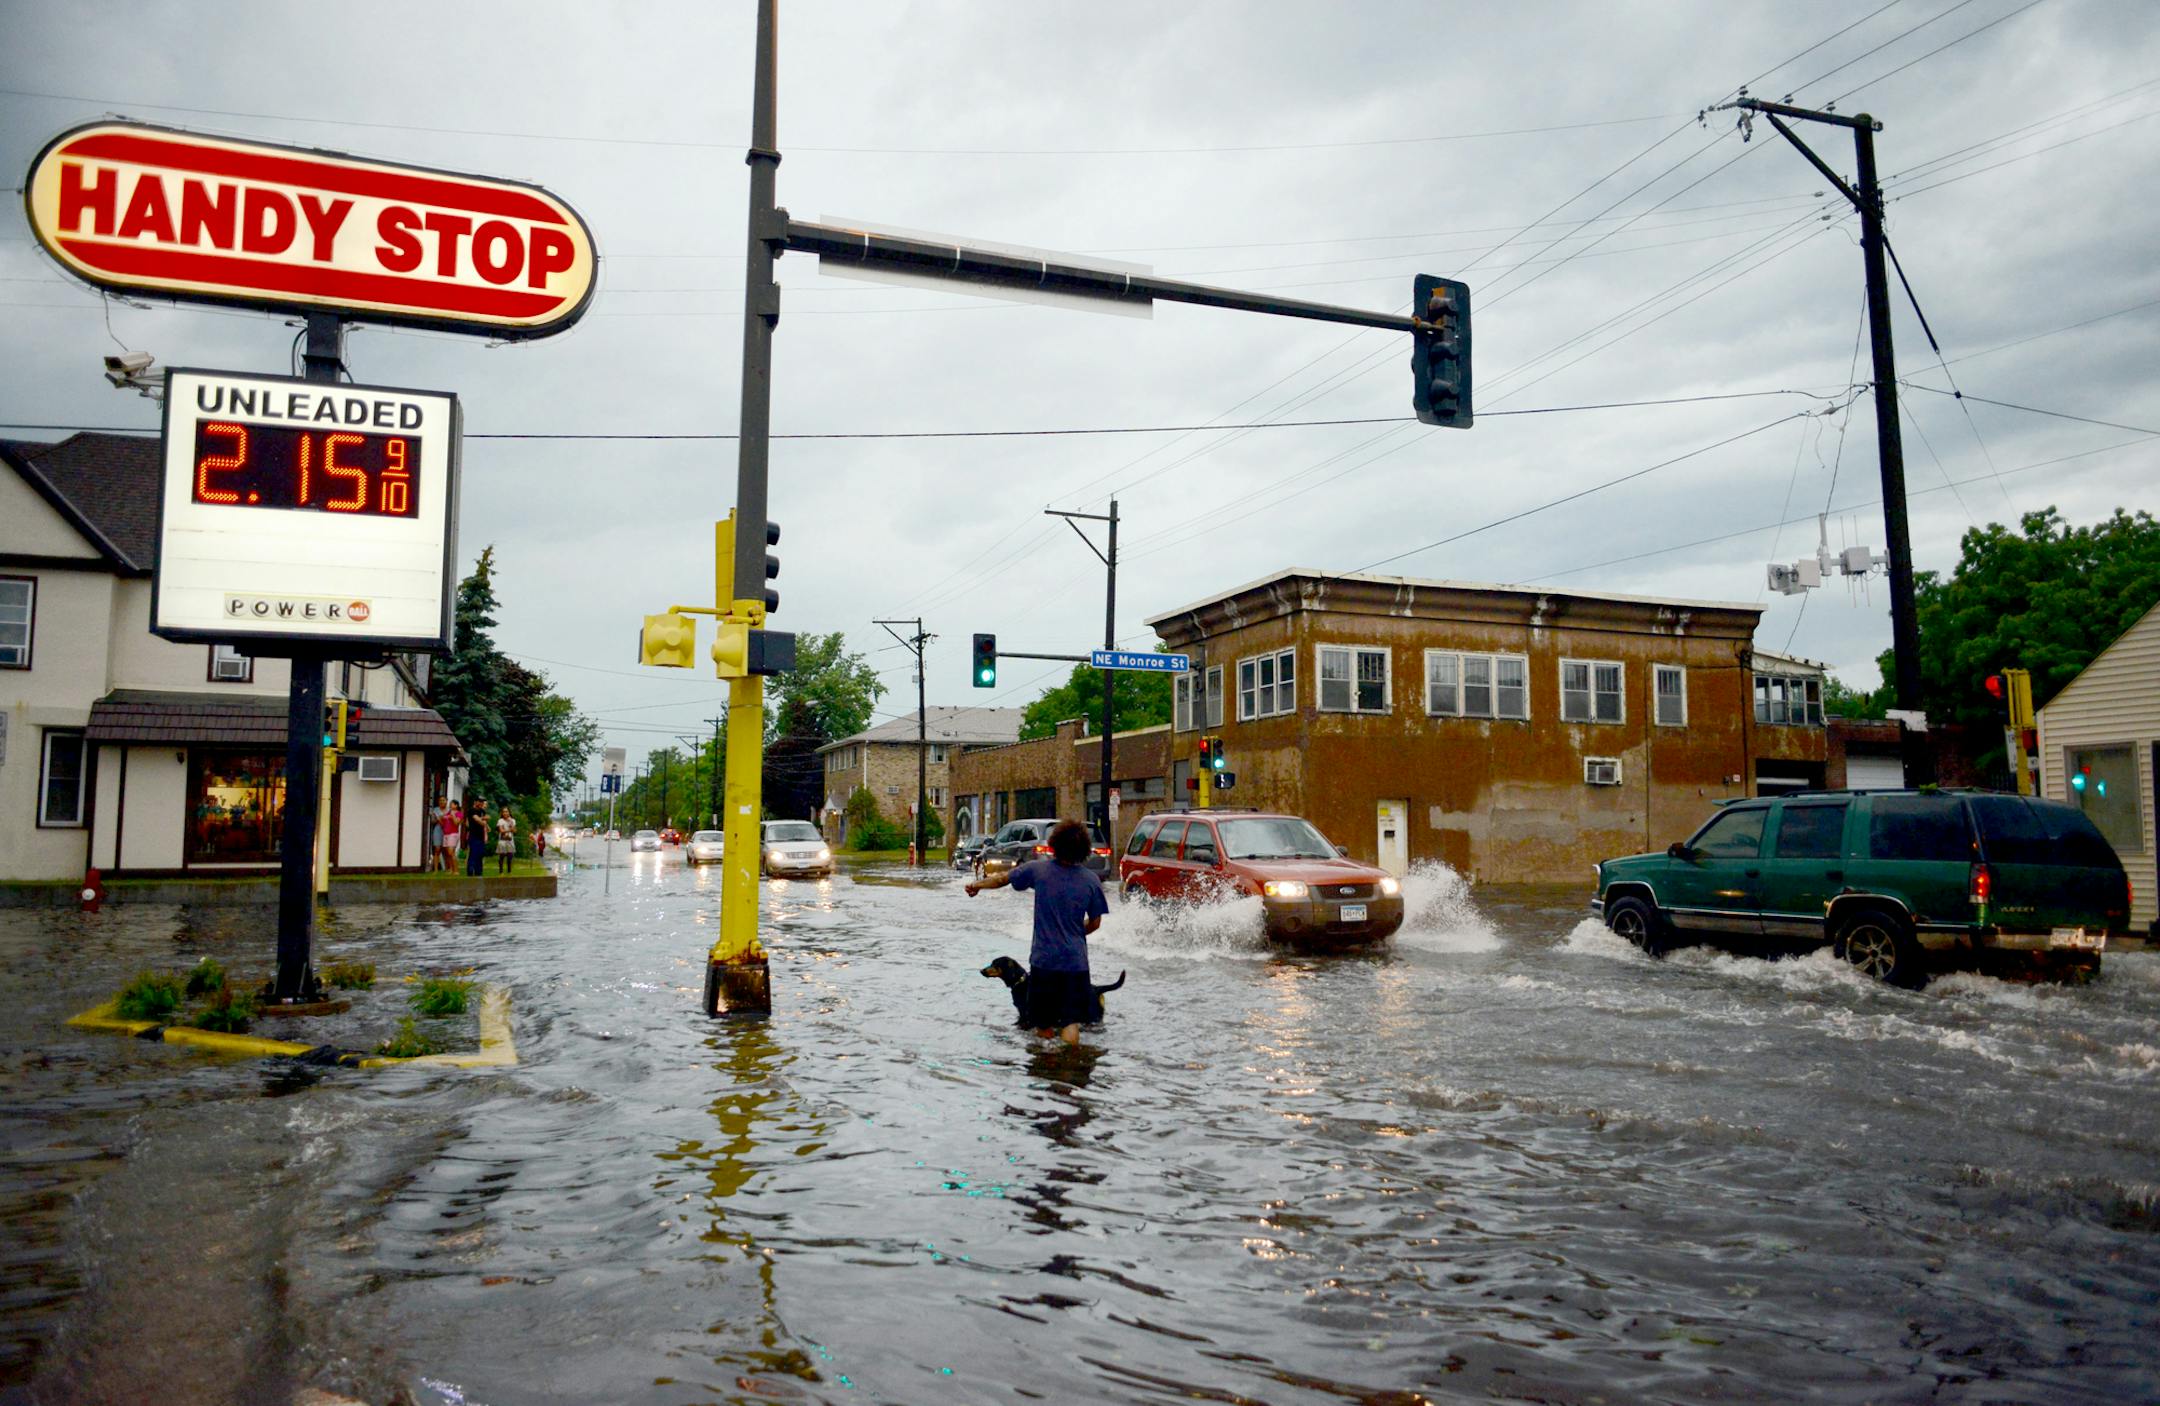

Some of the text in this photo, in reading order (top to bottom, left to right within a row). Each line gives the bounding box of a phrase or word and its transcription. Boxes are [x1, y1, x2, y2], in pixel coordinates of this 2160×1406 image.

[57, 161, 575, 289] HANDY STOP
[197, 384, 424, 430] UNLEADED
[199, 422, 369, 511] 2.15
[387, 438, 406, 471] 9
[381, 481, 408, 513] 10
[231, 599, 340, 618] POWER
[1095, 653, 1185, 669] NE Monroe St
